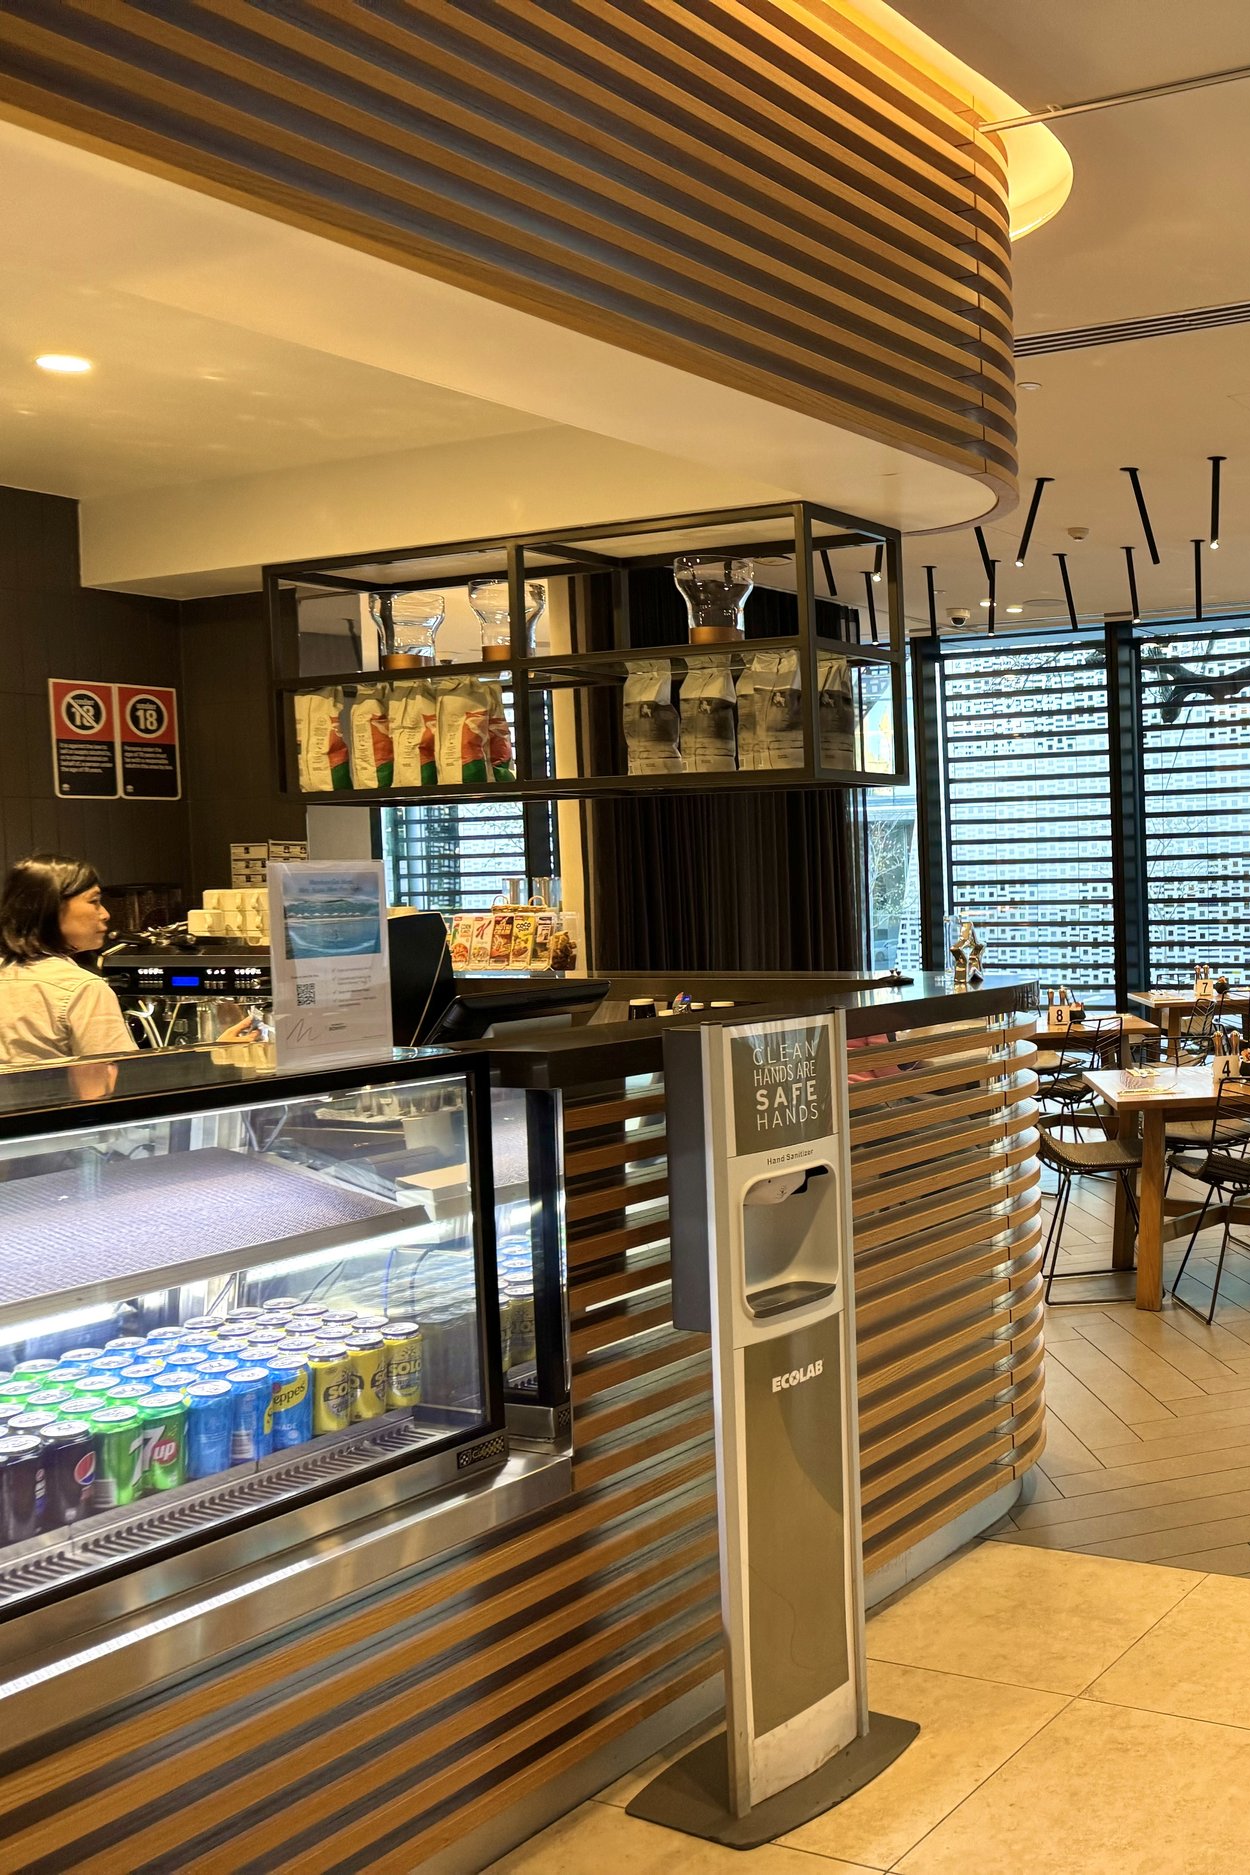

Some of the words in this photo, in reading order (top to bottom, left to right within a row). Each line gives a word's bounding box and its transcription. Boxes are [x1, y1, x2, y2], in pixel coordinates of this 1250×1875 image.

[135, 709, 158, 730] 18
[1202, 982, 1208, 994] 7
[1056, 1009, 1063, 1023] 8
[752, 1040, 816, 1066] CLEAN
[753, 1064, 794, 1087] HANDS
[796, 1059, 817, 1080] ARE
[1222, 1060, 1231, 1077] 4
[756, 1079, 818, 1111] SAFE
[757, 1102, 819, 1131] HANDS
[766, 1154, 785, 1166] Hand
[786, 1148, 814, 1161] Sanitizer
[771, 1359, 823, 1393] ECOLAB
